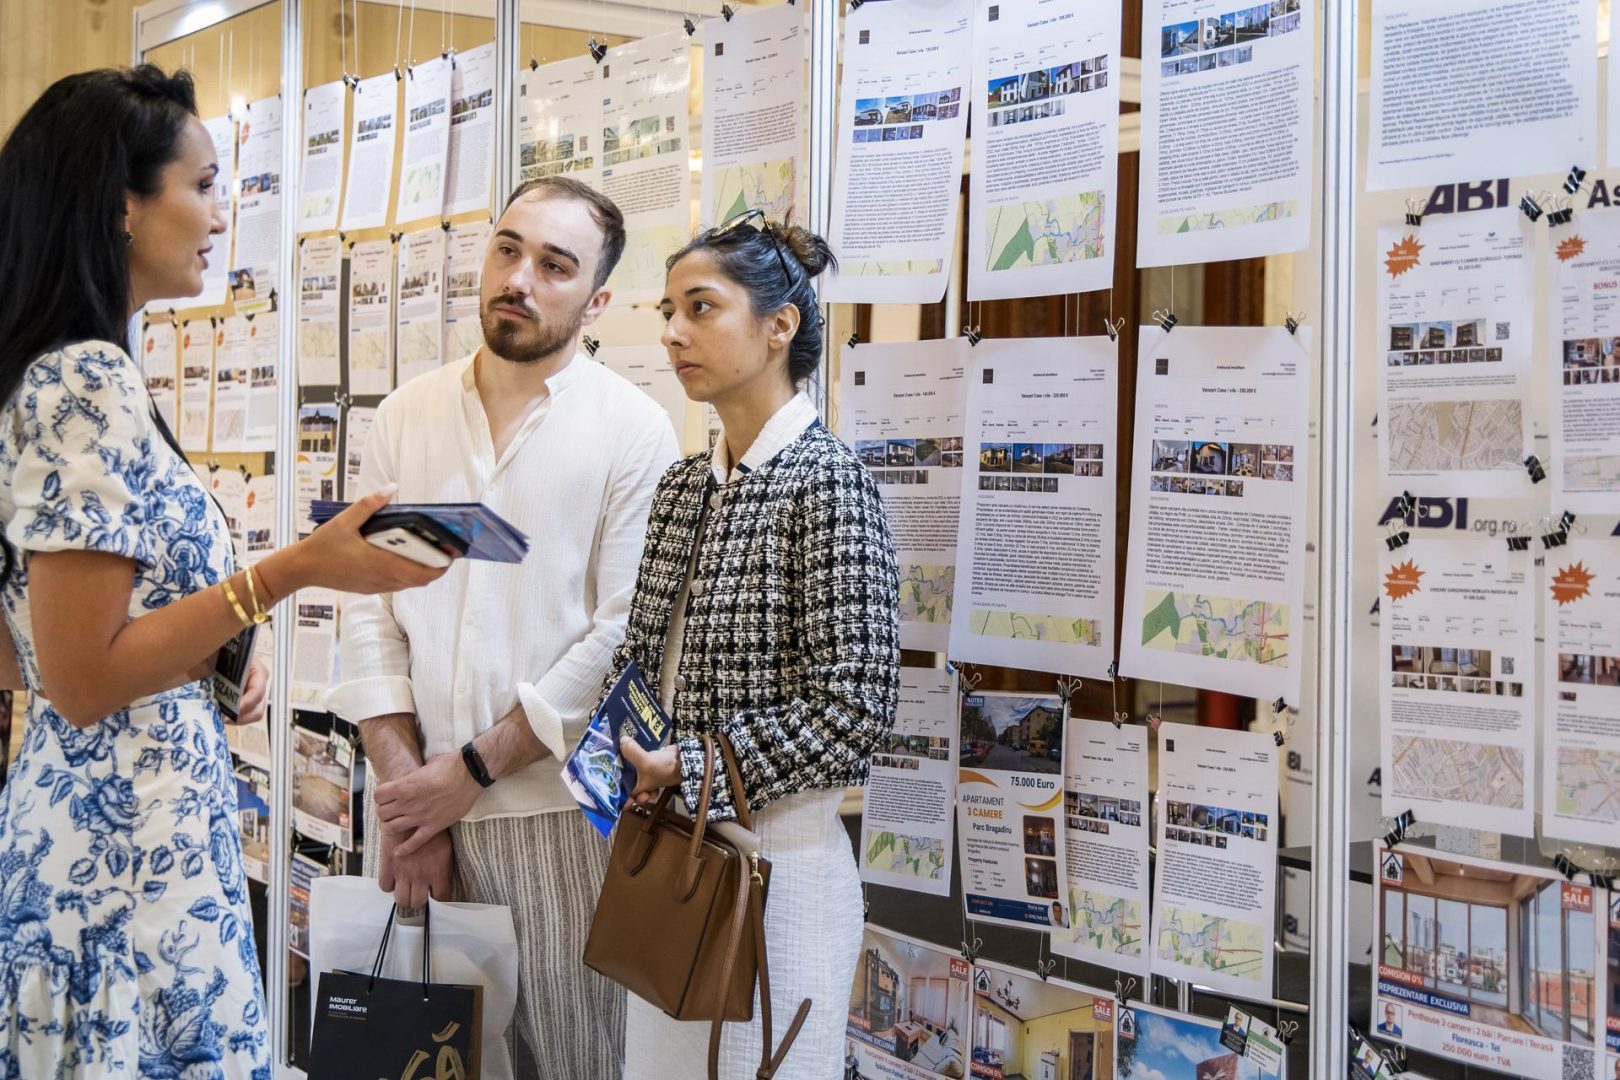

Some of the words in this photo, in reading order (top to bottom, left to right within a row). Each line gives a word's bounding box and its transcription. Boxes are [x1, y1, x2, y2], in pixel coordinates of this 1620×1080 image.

[1010, 777, 1035, 789] 75.000
[1036, 778, 1055, 790] Euro
[962, 794, 1005, 807] APARTAMENT
[967, 807, 972, 816] 3
[973, 807, 1003, 820] CAMERE
[972, 823, 985, 832] Parc
[986, 824, 1012, 835] Bragadiru
[1562, 891, 1590, 906] SALE
[951, 964, 968, 975] SALE
[1378, 982, 1428, 1004] REPREZENTARE
[1430, 996, 1468, 1014] EXCLUSIVA
[1094, 1004, 1112, 1017] SALE
[1408, 1010, 1440, 1025] Penthouse
[1447, 1022, 1472, 1034] camere
[1497, 1032, 1524, 1046] Parcare
[1452, 1033, 1484, 1049] Floreasca
